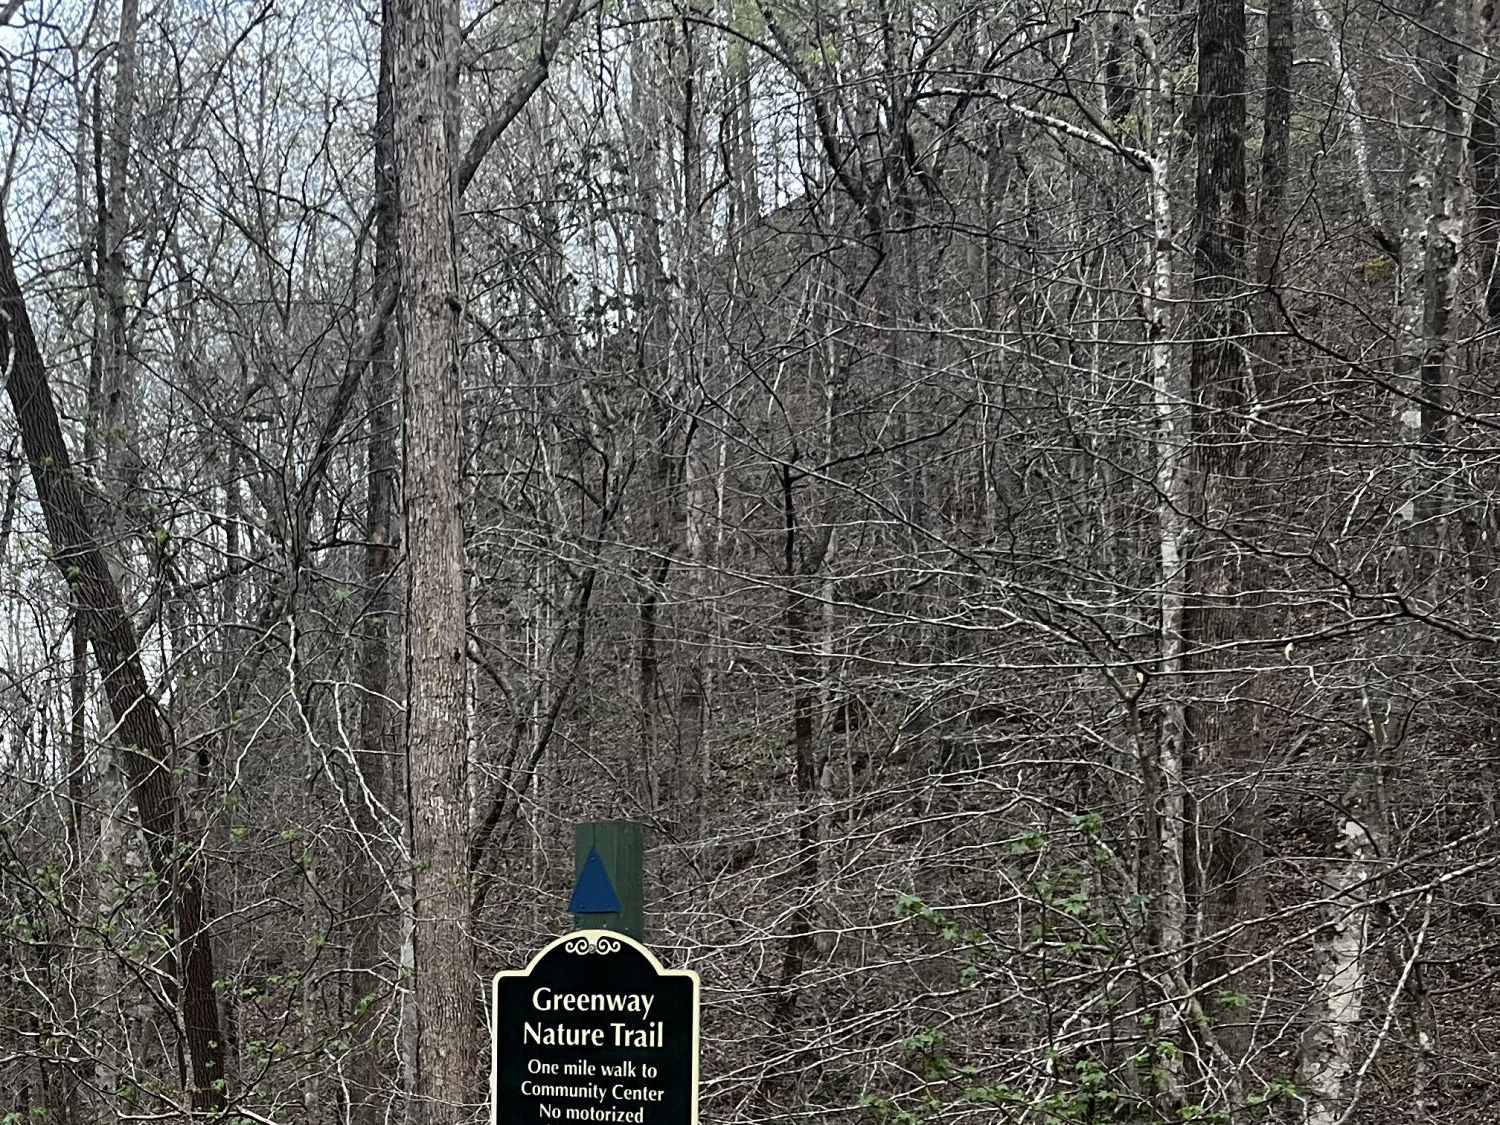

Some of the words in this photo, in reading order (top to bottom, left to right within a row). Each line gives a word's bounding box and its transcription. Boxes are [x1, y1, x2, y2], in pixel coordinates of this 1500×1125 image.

[533, 987, 654, 1020] Greenway
[524, 1022, 604, 1046] Nature
[610, 1022, 663, 1047] Trail
[528, 1059, 559, 1075] One
[564, 1060, 596, 1075] mile
[601, 1061, 636, 1077] walk
[642, 1064, 657, 1078] to
[521, 1081, 606, 1103] Community
[612, 1084, 664, 1101] Center
[540, 1104, 561, 1118] No
[567, 1106, 643, 1123] motorized
